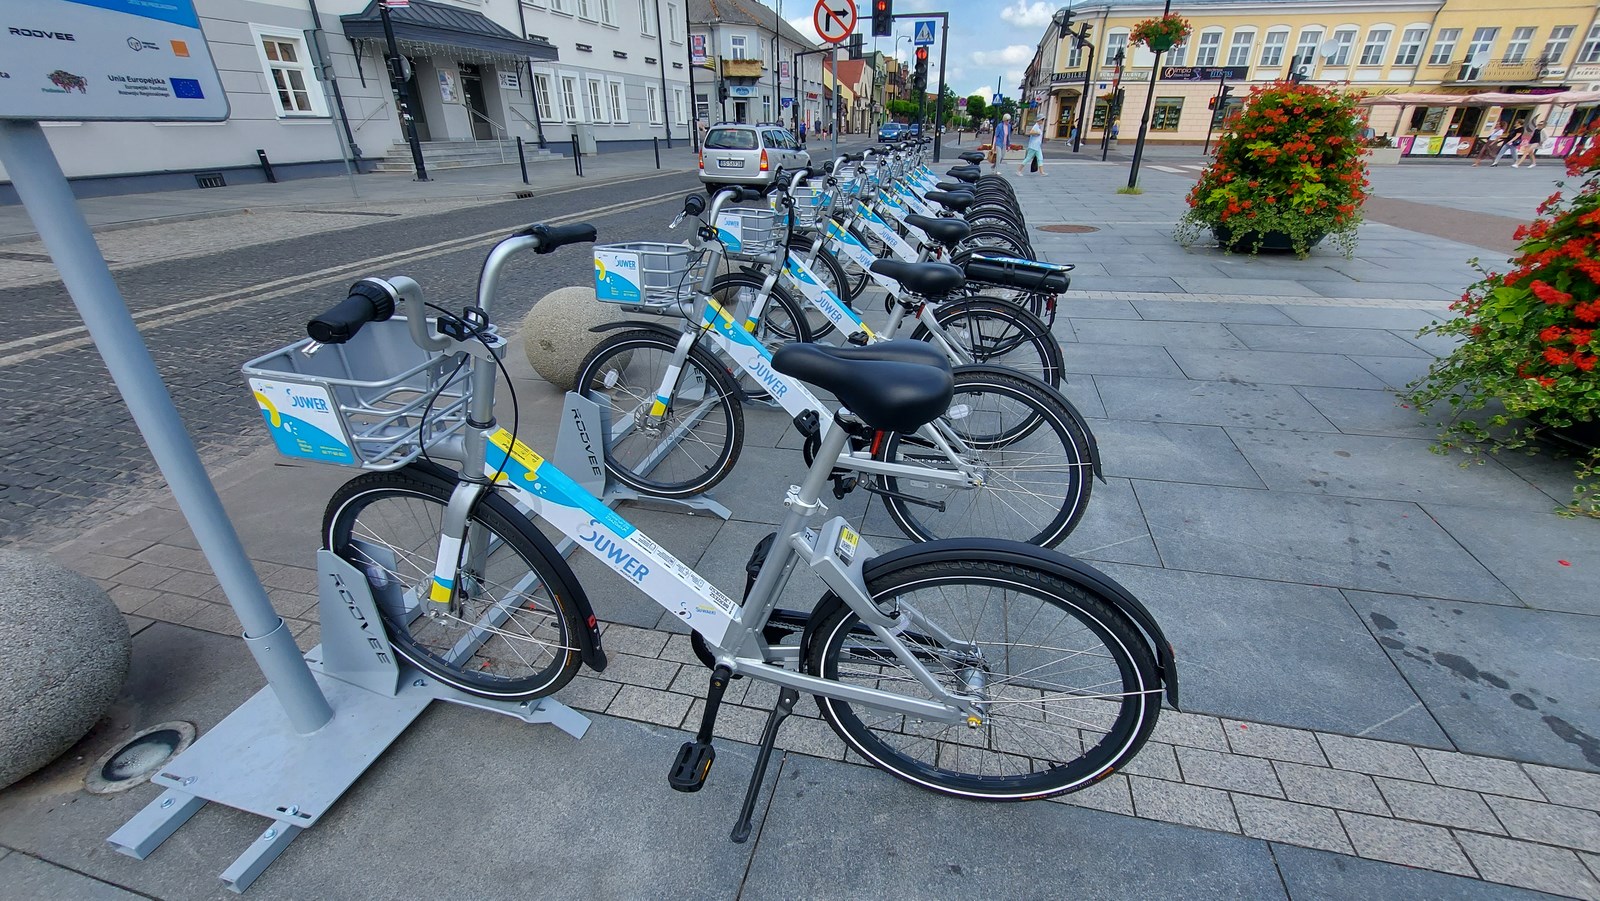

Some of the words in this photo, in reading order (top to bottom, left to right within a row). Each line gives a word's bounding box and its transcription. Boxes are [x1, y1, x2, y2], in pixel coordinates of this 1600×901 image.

[8, 27, 76, 42] ROOVEE
[126, 75, 166, 86] Europejska
[614, 255, 636, 268] SUWER
[814, 290, 843, 323] SUWER
[747, 353, 788, 398] SUWER
[286, 388, 329, 411] SUWER
[570, 407, 602, 477] ROOVEE
[576, 518, 650, 582] SUWER
[328, 572, 392, 665] ROOVEE
